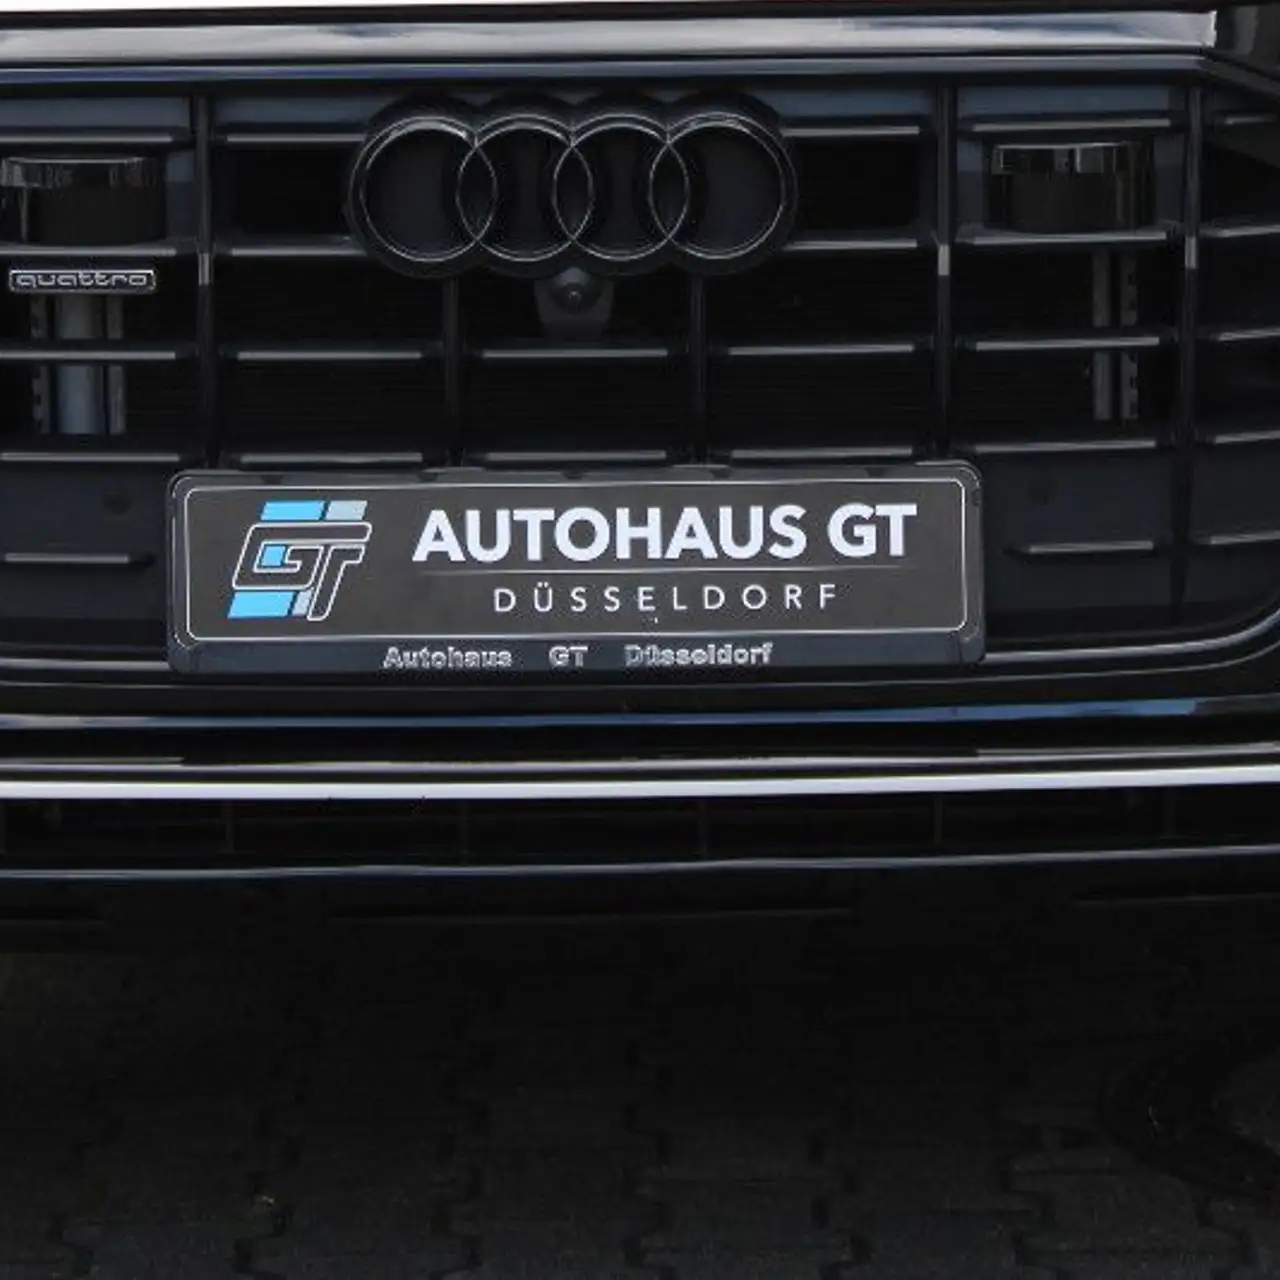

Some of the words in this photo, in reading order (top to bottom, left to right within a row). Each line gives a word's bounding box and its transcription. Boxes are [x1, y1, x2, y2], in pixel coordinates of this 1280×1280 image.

[16, 272, 147, 288] quattro
[412, 504, 808, 563] AUTOHAUS
[826, 502, 918, 559] GT
[493, 581, 837, 613] DÜSSELDORF
[382, 645, 513, 669] Autohaus
[548, 645, 589, 667] GT
[624, 642, 774, 666] Düsseldorf
